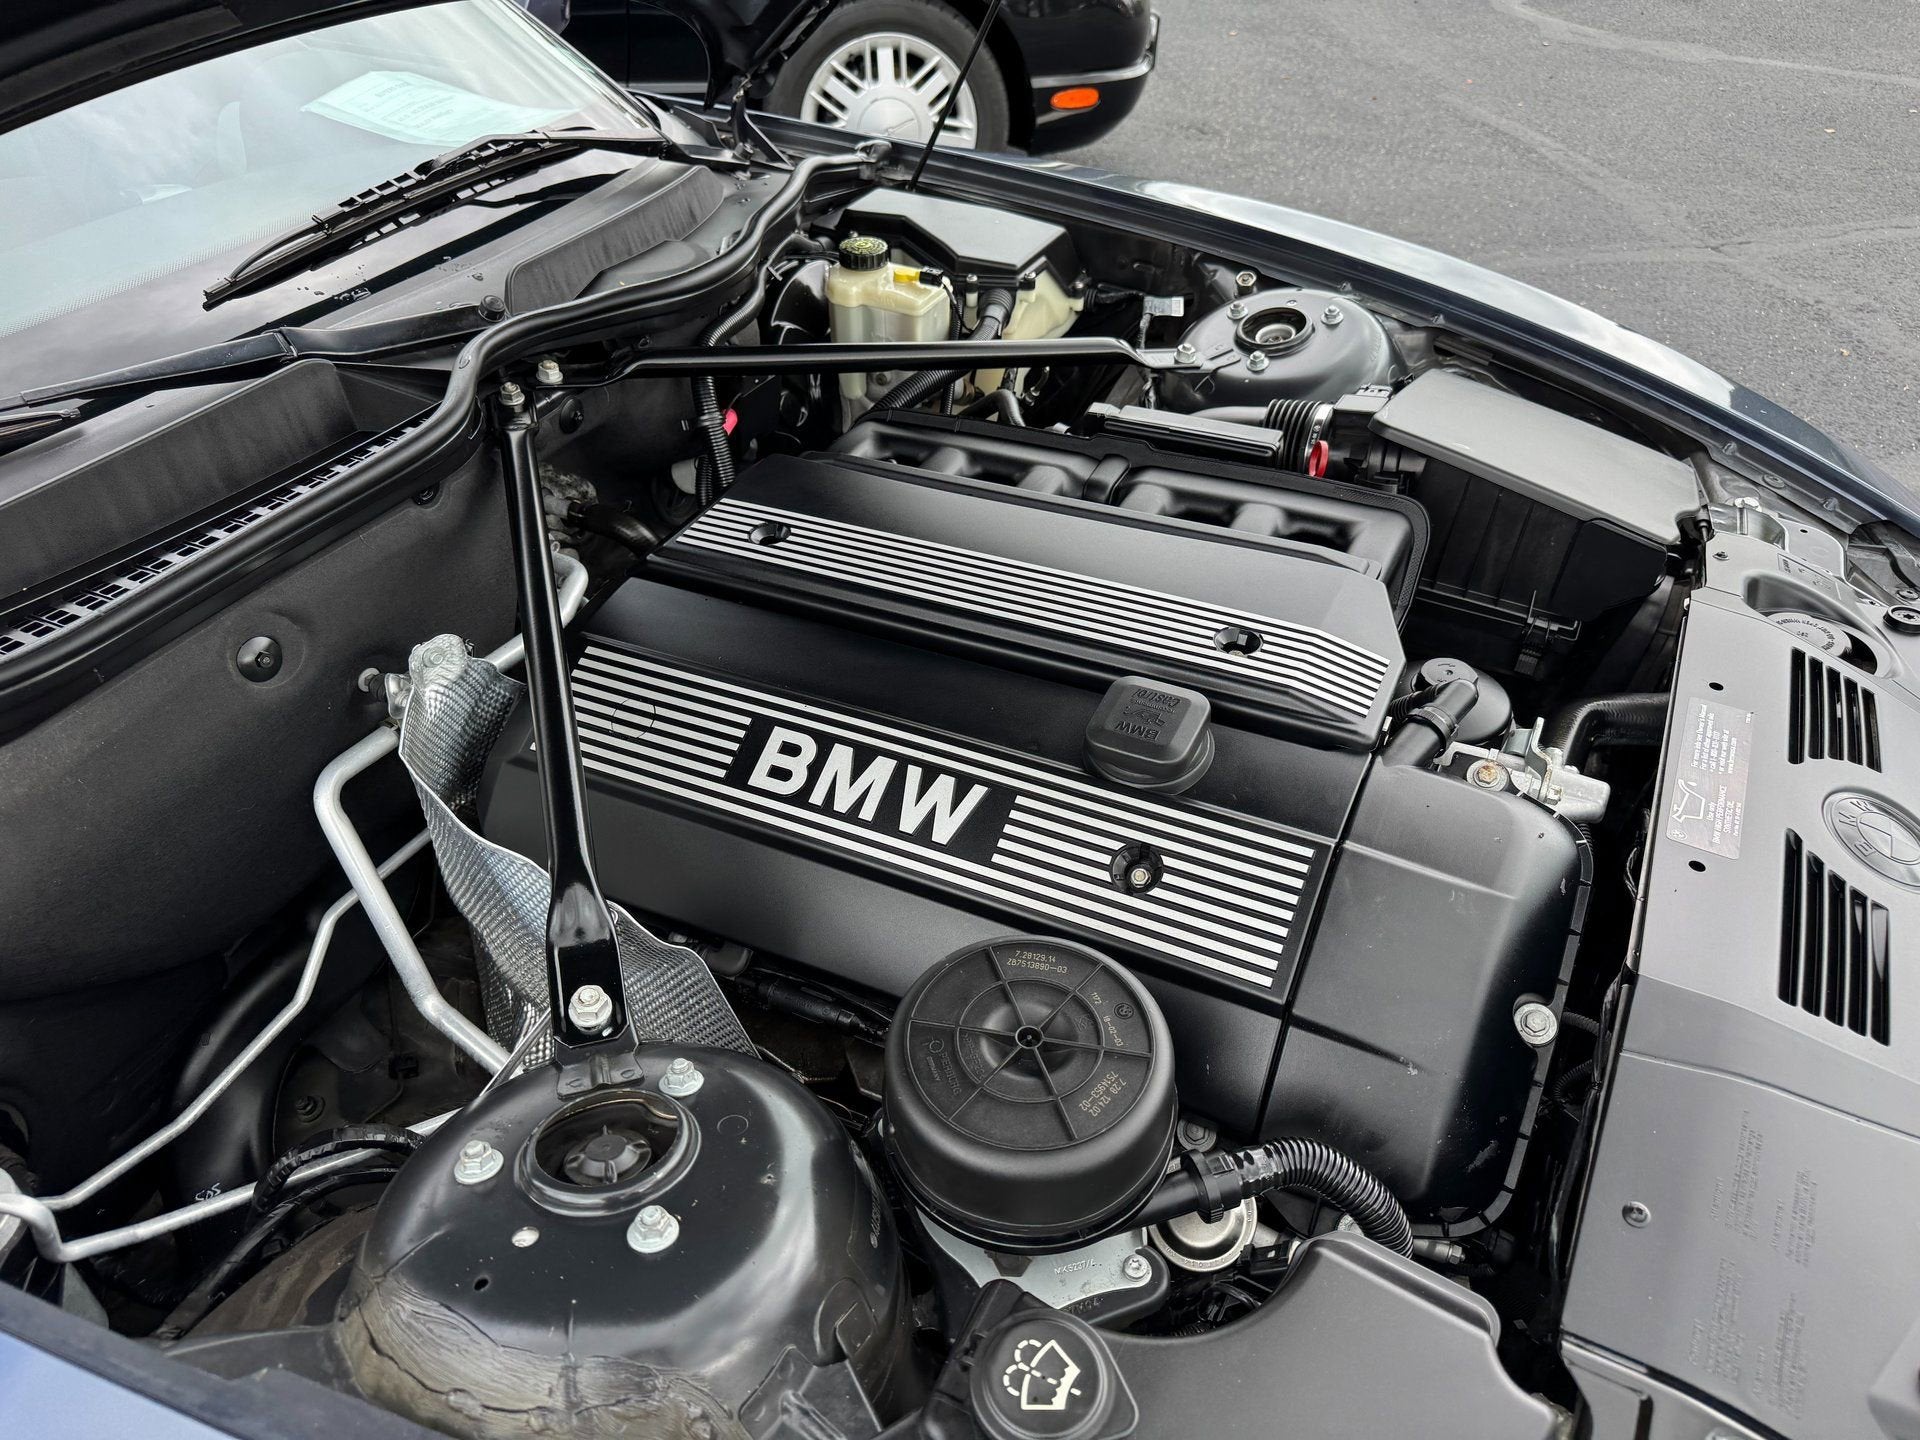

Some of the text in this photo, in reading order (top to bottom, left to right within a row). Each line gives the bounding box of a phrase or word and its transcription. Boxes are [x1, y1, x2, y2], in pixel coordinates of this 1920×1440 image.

[1131, 688, 1181, 707] Castrol
[1114, 720, 1161, 741] BMW
[747, 725, 989, 846] BMW
[1838, 800, 1876, 858] BMW
